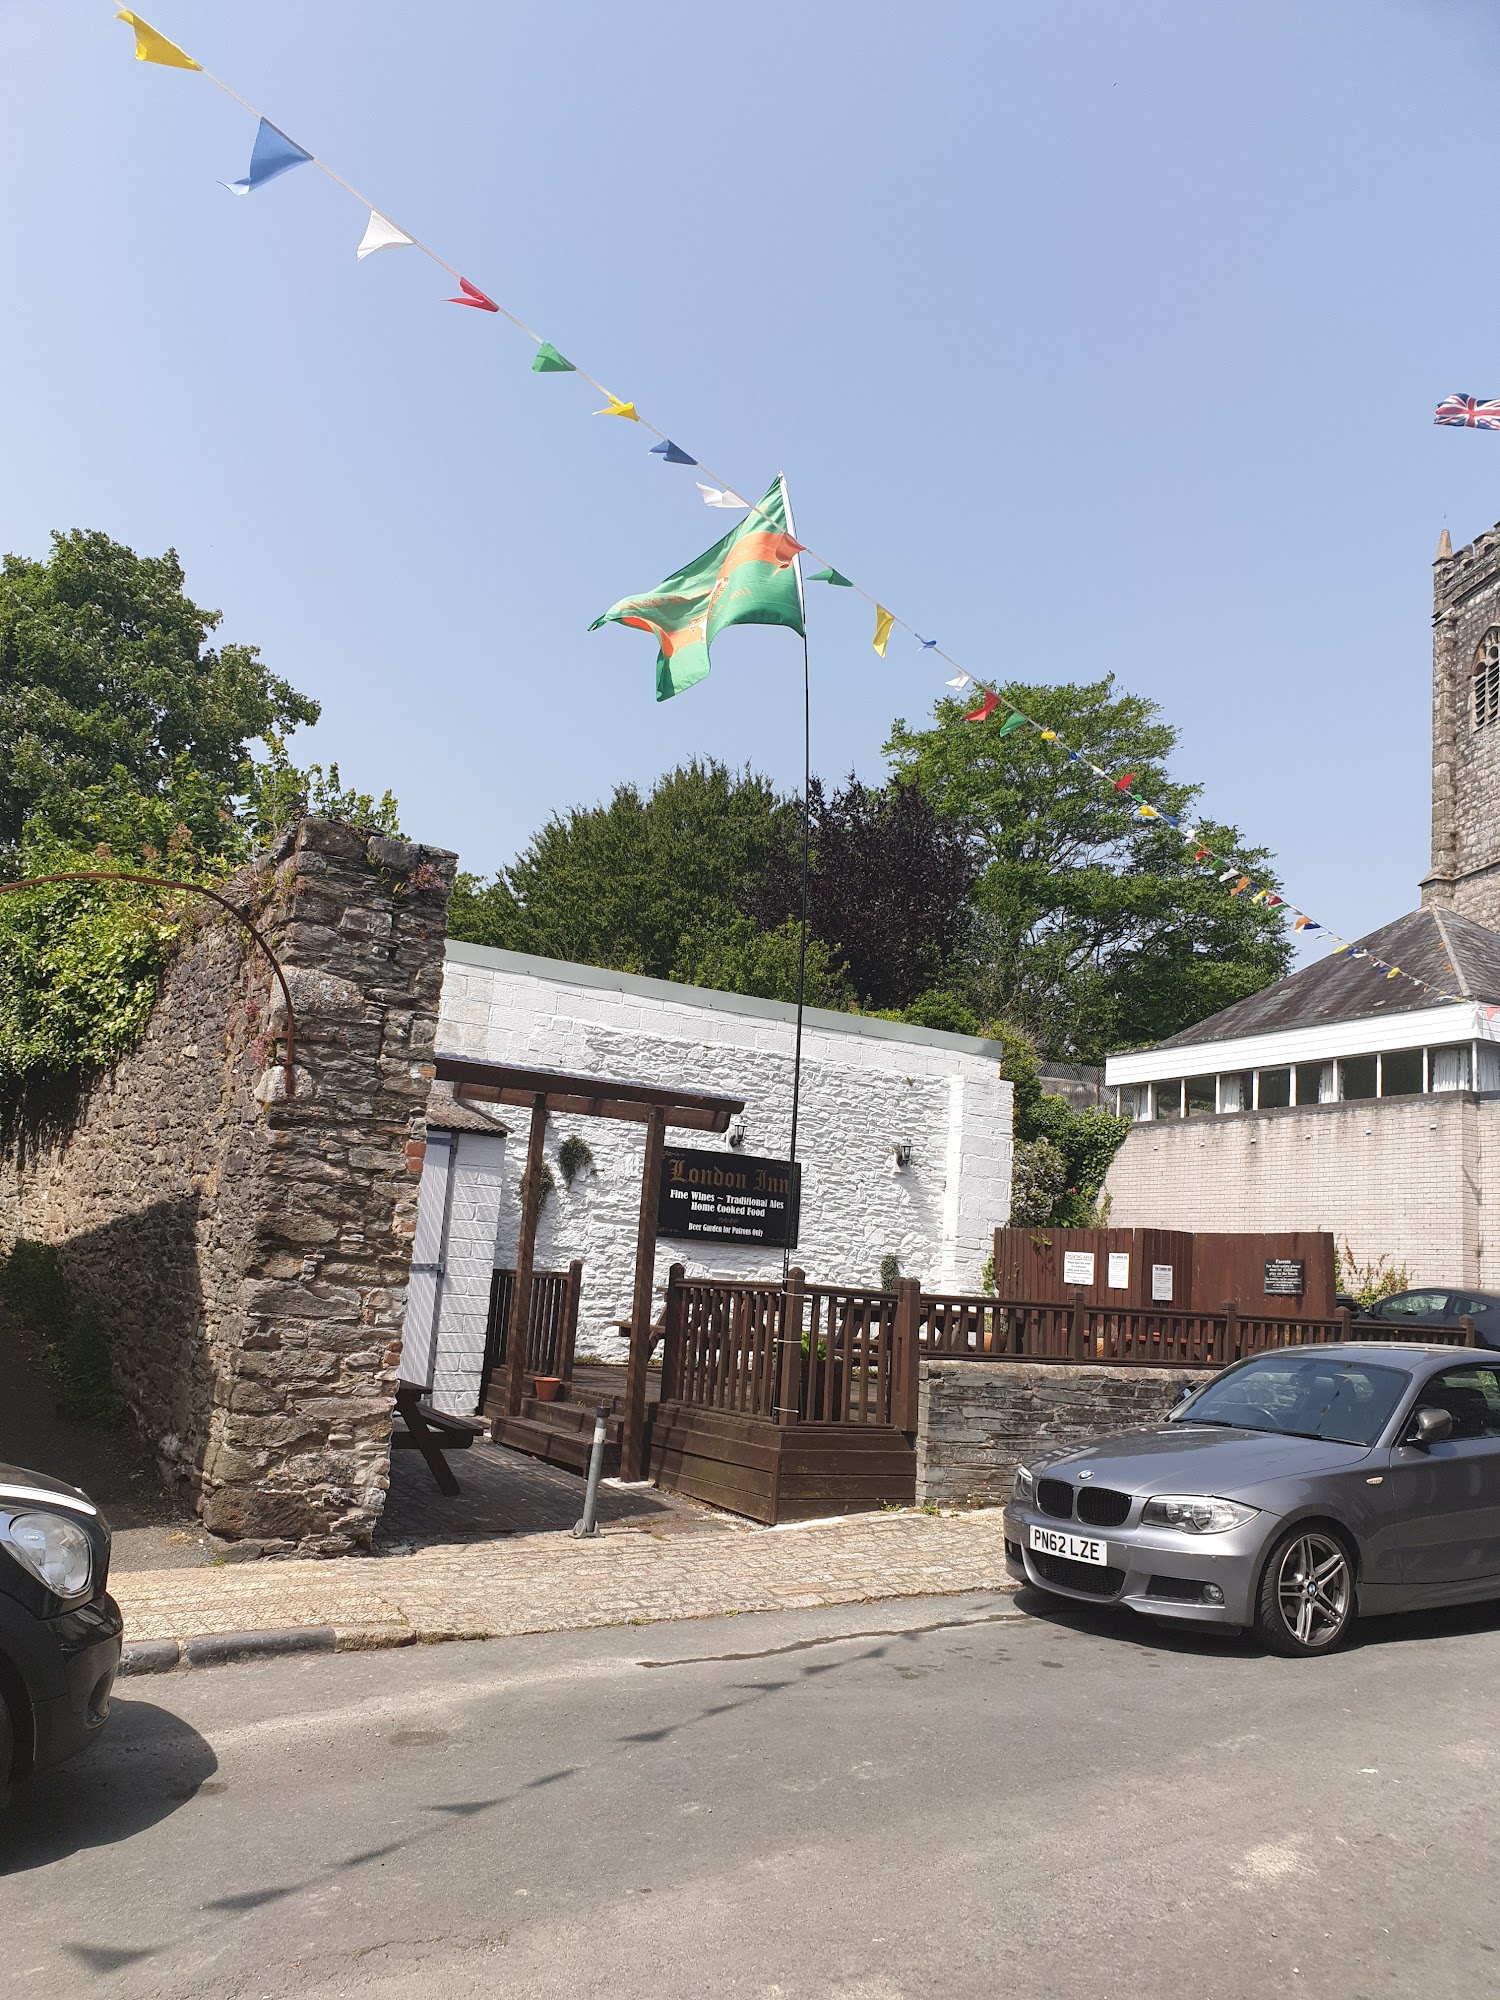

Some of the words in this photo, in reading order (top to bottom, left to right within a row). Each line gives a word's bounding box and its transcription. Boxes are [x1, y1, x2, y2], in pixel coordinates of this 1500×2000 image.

[669, 1159, 747, 1188] London
[753, 1169, 789, 1194] Inn
[670, 1189, 689, 1200] Fine
[691, 1191, 715, 1202] Wines
[726, 1195, 768, 1208] Traditional
[769, 1199, 784, 1209] Ales
[691, 1202, 715, 1212] Home
[717, 1204, 745, 1215] Cooked
[747, 1207, 766, 1217] Food
[688, 1222, 702, 1231] Beer
[703, 1224, 722, 1233] Garden
[732, 1227, 751, 1235] Patrons
[752, 1229, 764, 1237] Only
[1034, 1530, 1066, 1554] PN62
[1070, 1538, 1100, 1561] LZE
